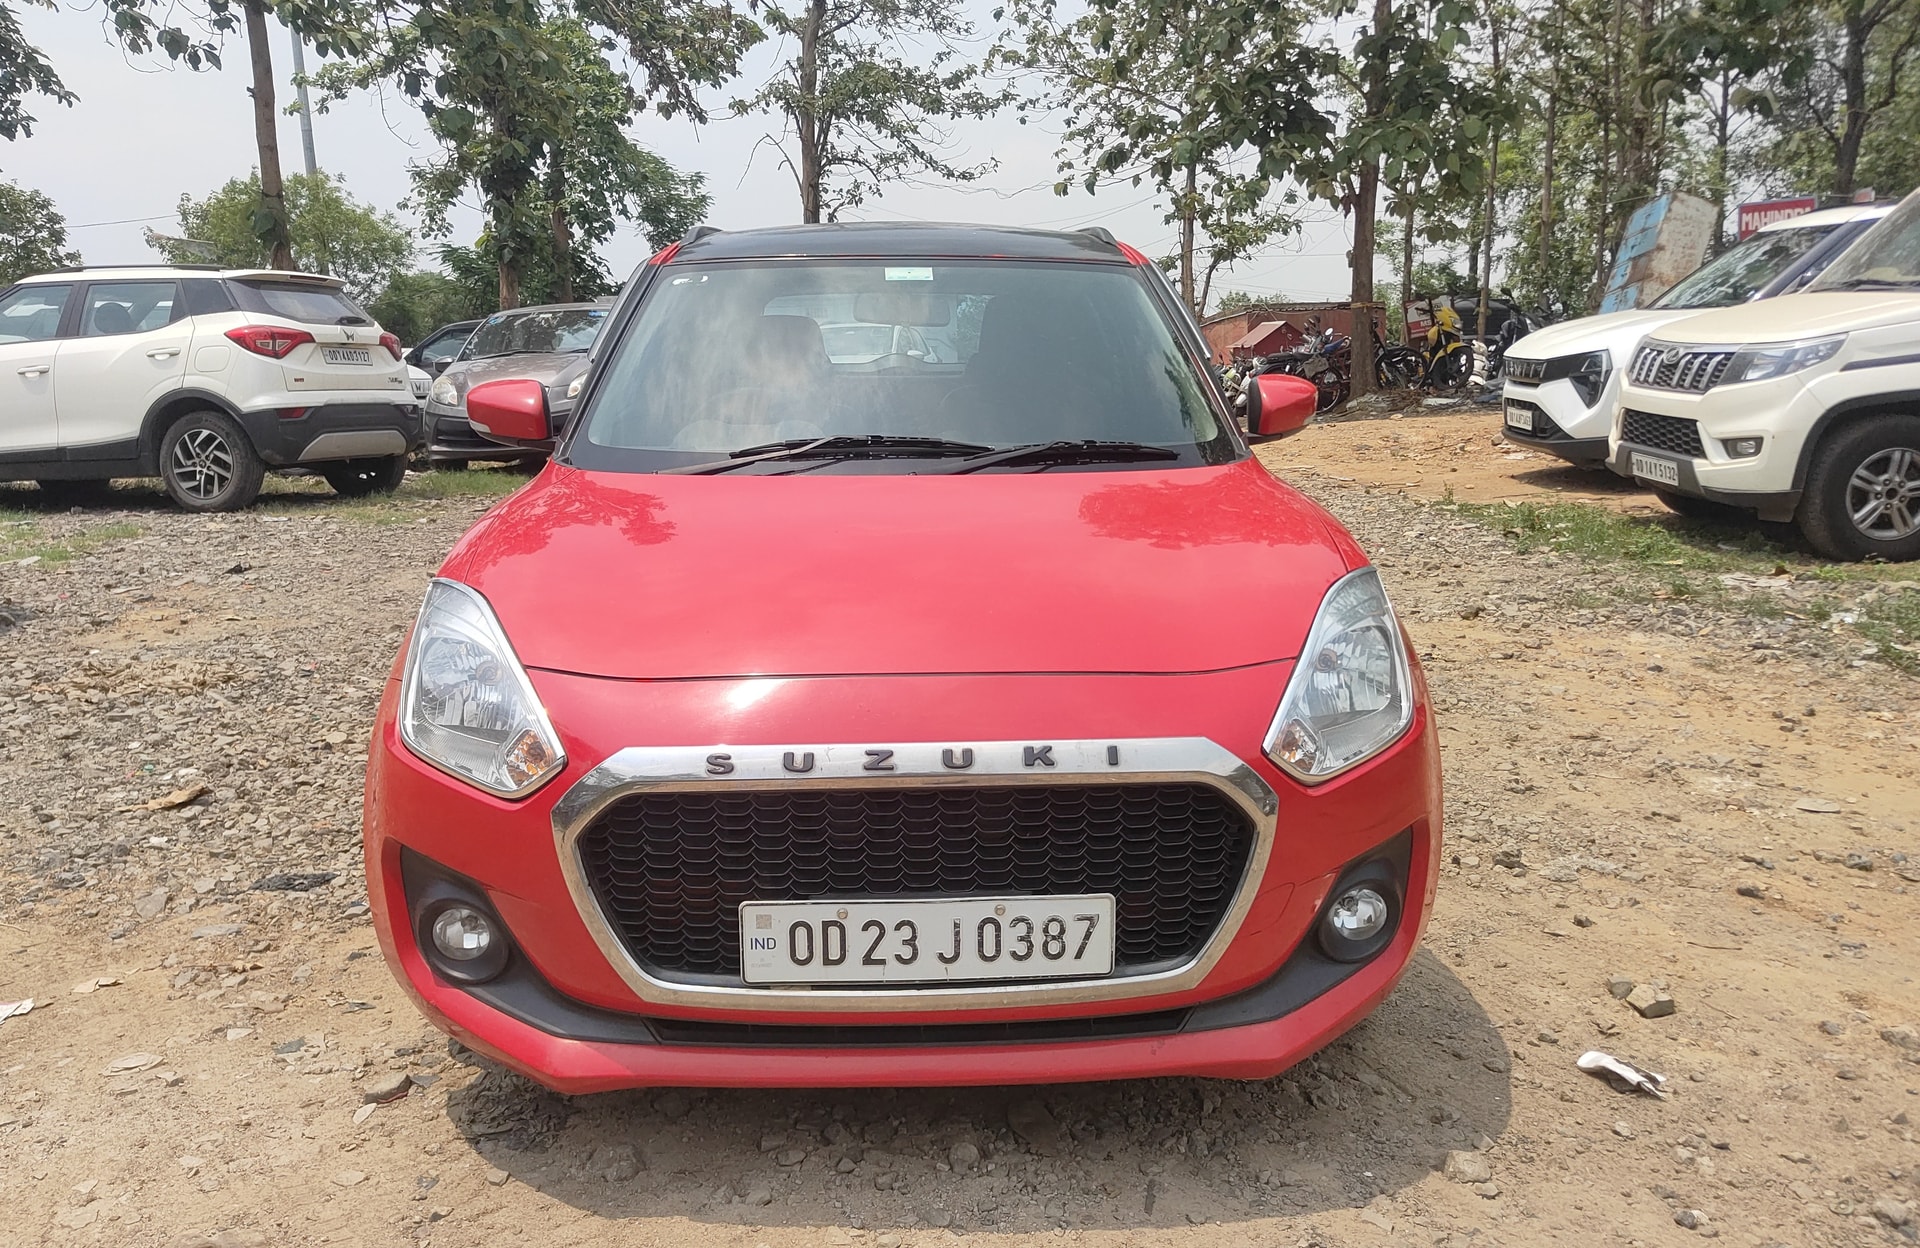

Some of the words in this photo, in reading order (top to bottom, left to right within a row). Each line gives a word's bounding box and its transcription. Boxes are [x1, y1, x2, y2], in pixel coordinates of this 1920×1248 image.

[706, 745, 1118, 775] SUZUKI
[750, 937, 777, 951] IND
[788, 919, 847, 967] OD
[861, 919, 919, 966] 23
